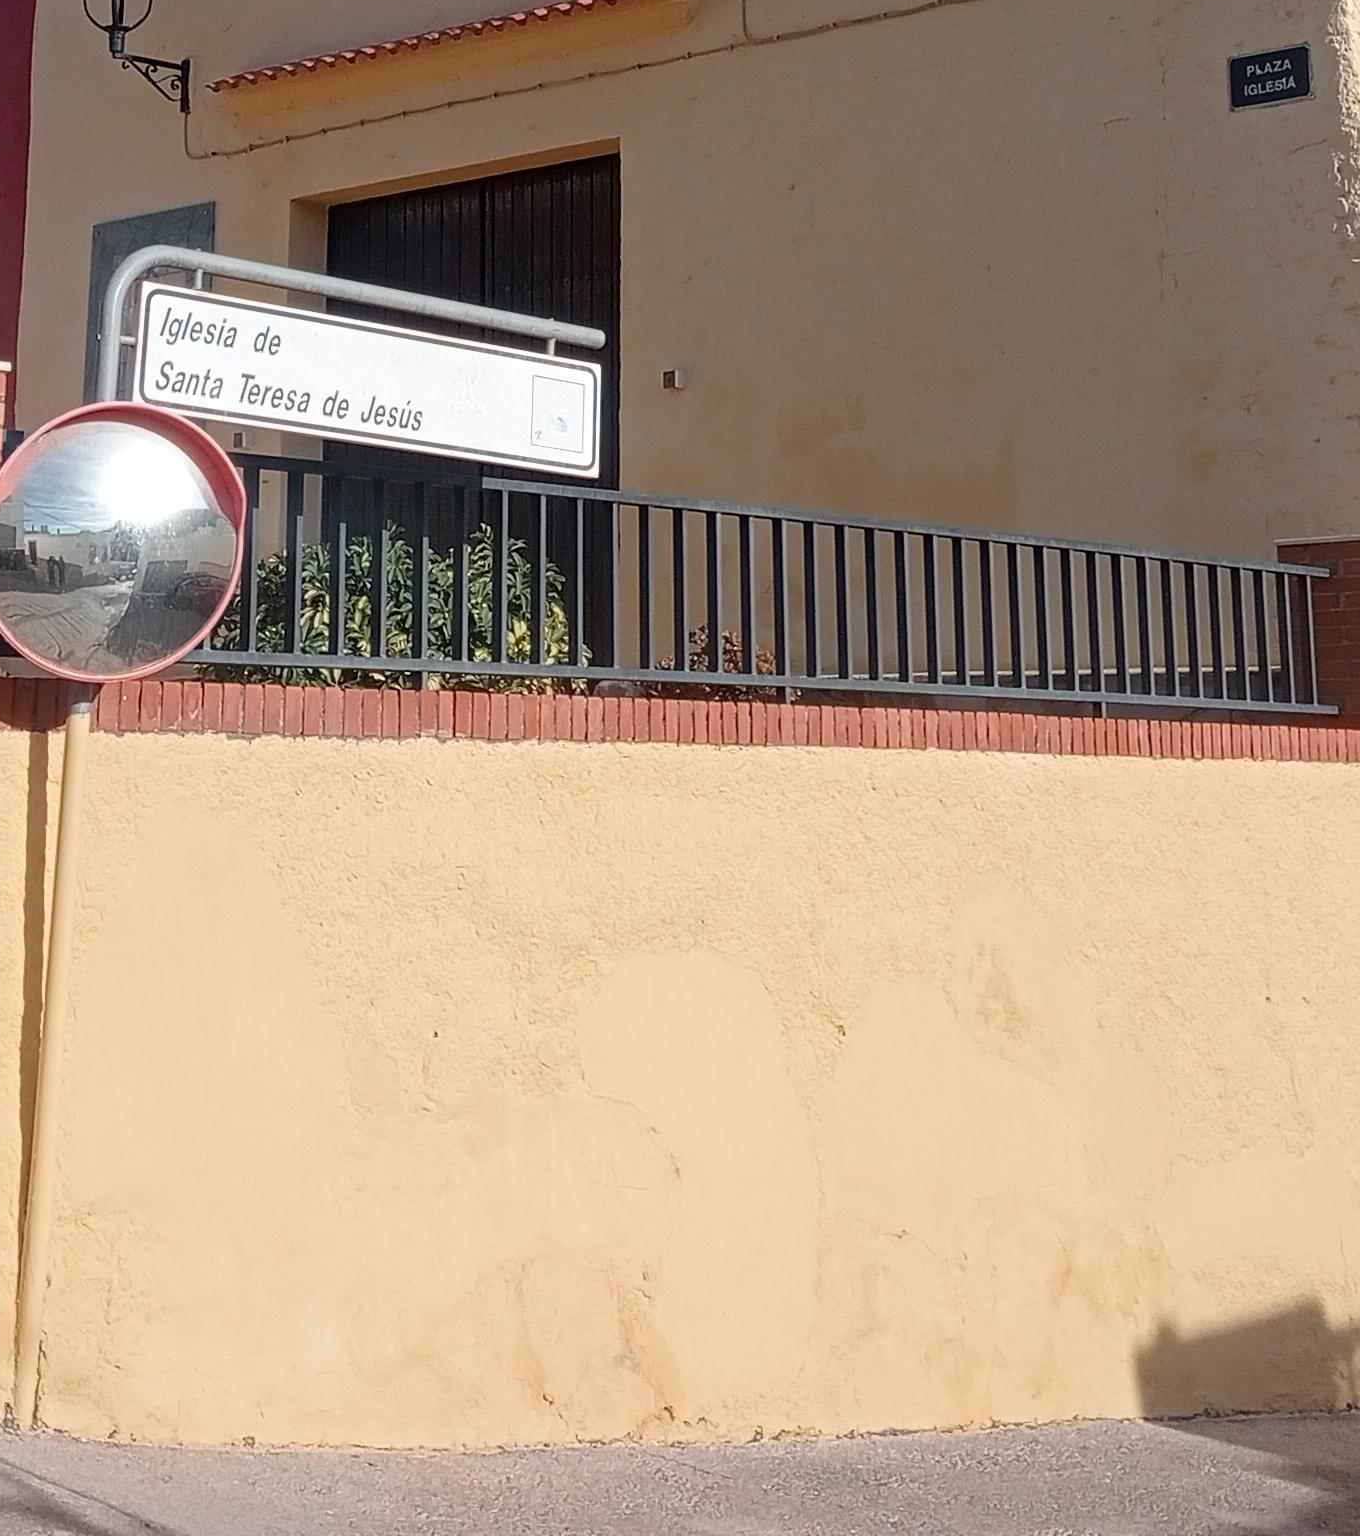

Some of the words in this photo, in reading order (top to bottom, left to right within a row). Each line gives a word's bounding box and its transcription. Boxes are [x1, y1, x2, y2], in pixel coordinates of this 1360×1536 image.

[1246, 58, 1292, 77] PLAZA
[1243, 75, 1296, 96] IGLESIA
[159, 307, 238, 349] Iglesia
[253, 326, 281, 356] de
[155, 360, 224, 399] Santa
[239, 373, 311, 414] Teresa
[322, 389, 349, 419] de
[360, 396, 423, 431] Jesús
